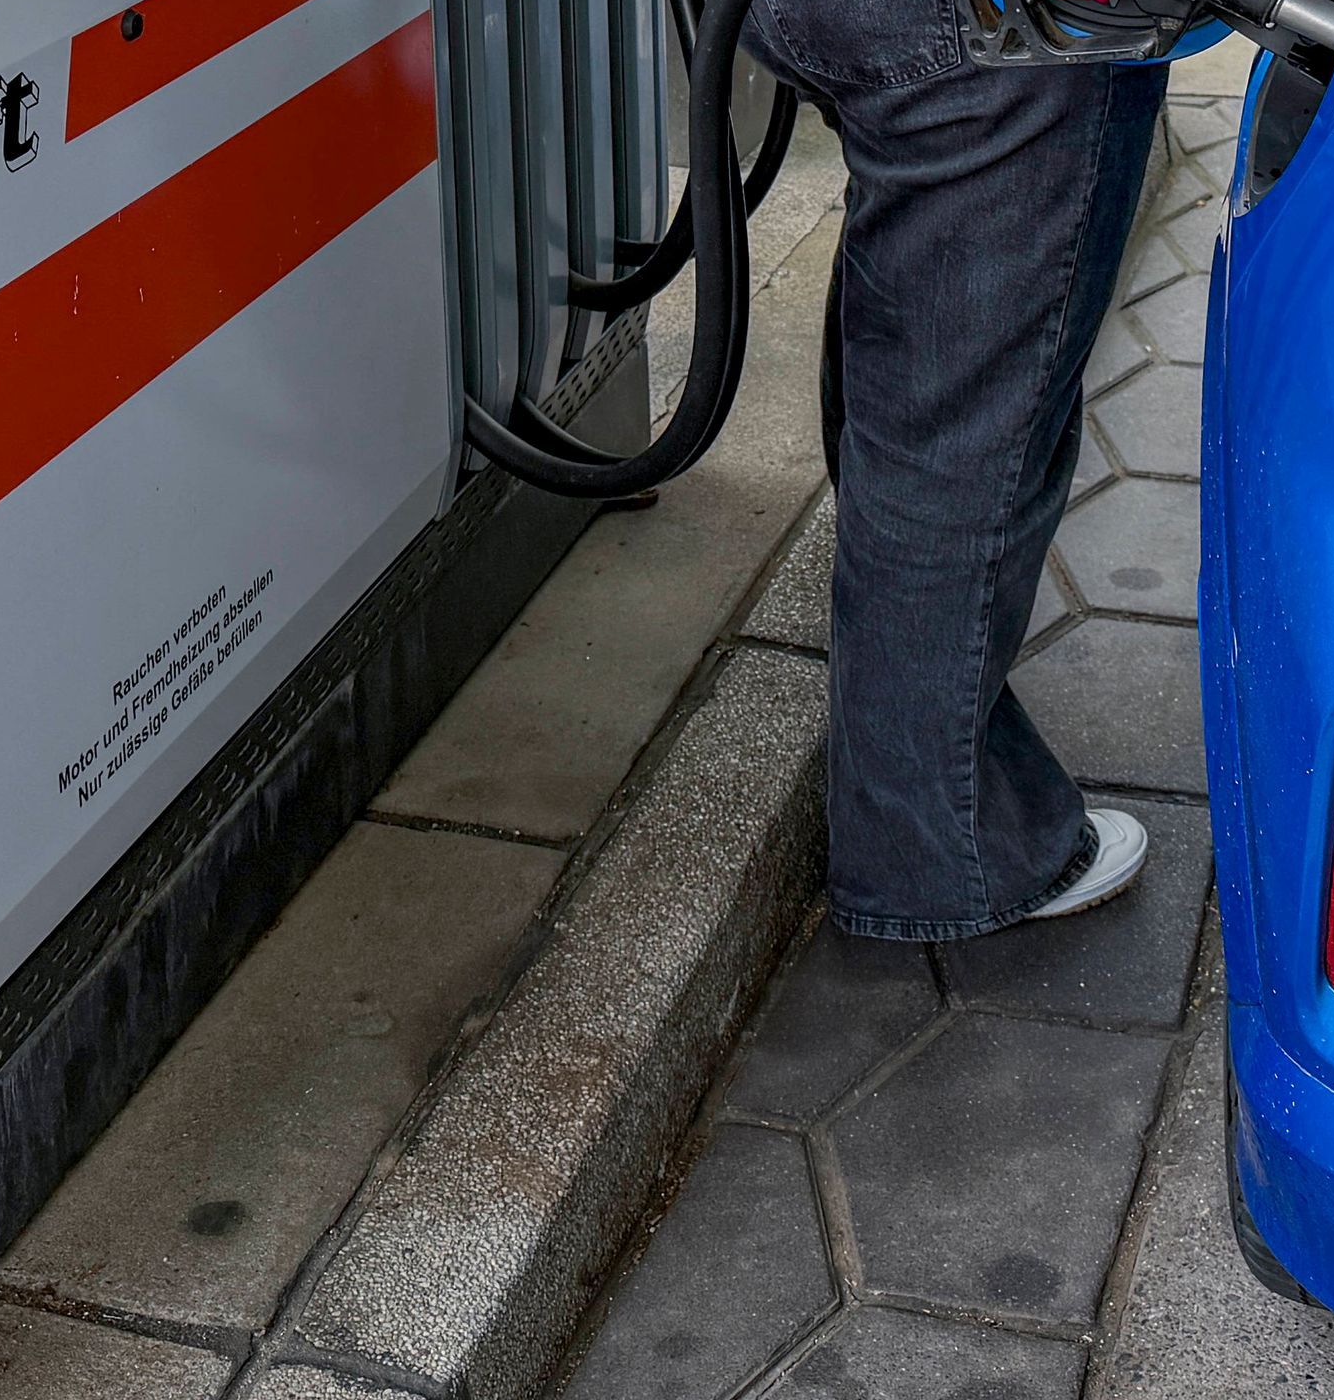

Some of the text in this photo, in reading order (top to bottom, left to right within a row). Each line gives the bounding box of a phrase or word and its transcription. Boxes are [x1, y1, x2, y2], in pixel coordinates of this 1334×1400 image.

[58, 567, 275, 794] Motor und Fremdheizung abstellen
[77, 609, 264, 808] Nur zulässige Gefäße befüllen
[112, 584, 227, 706] Rauchen verboten
